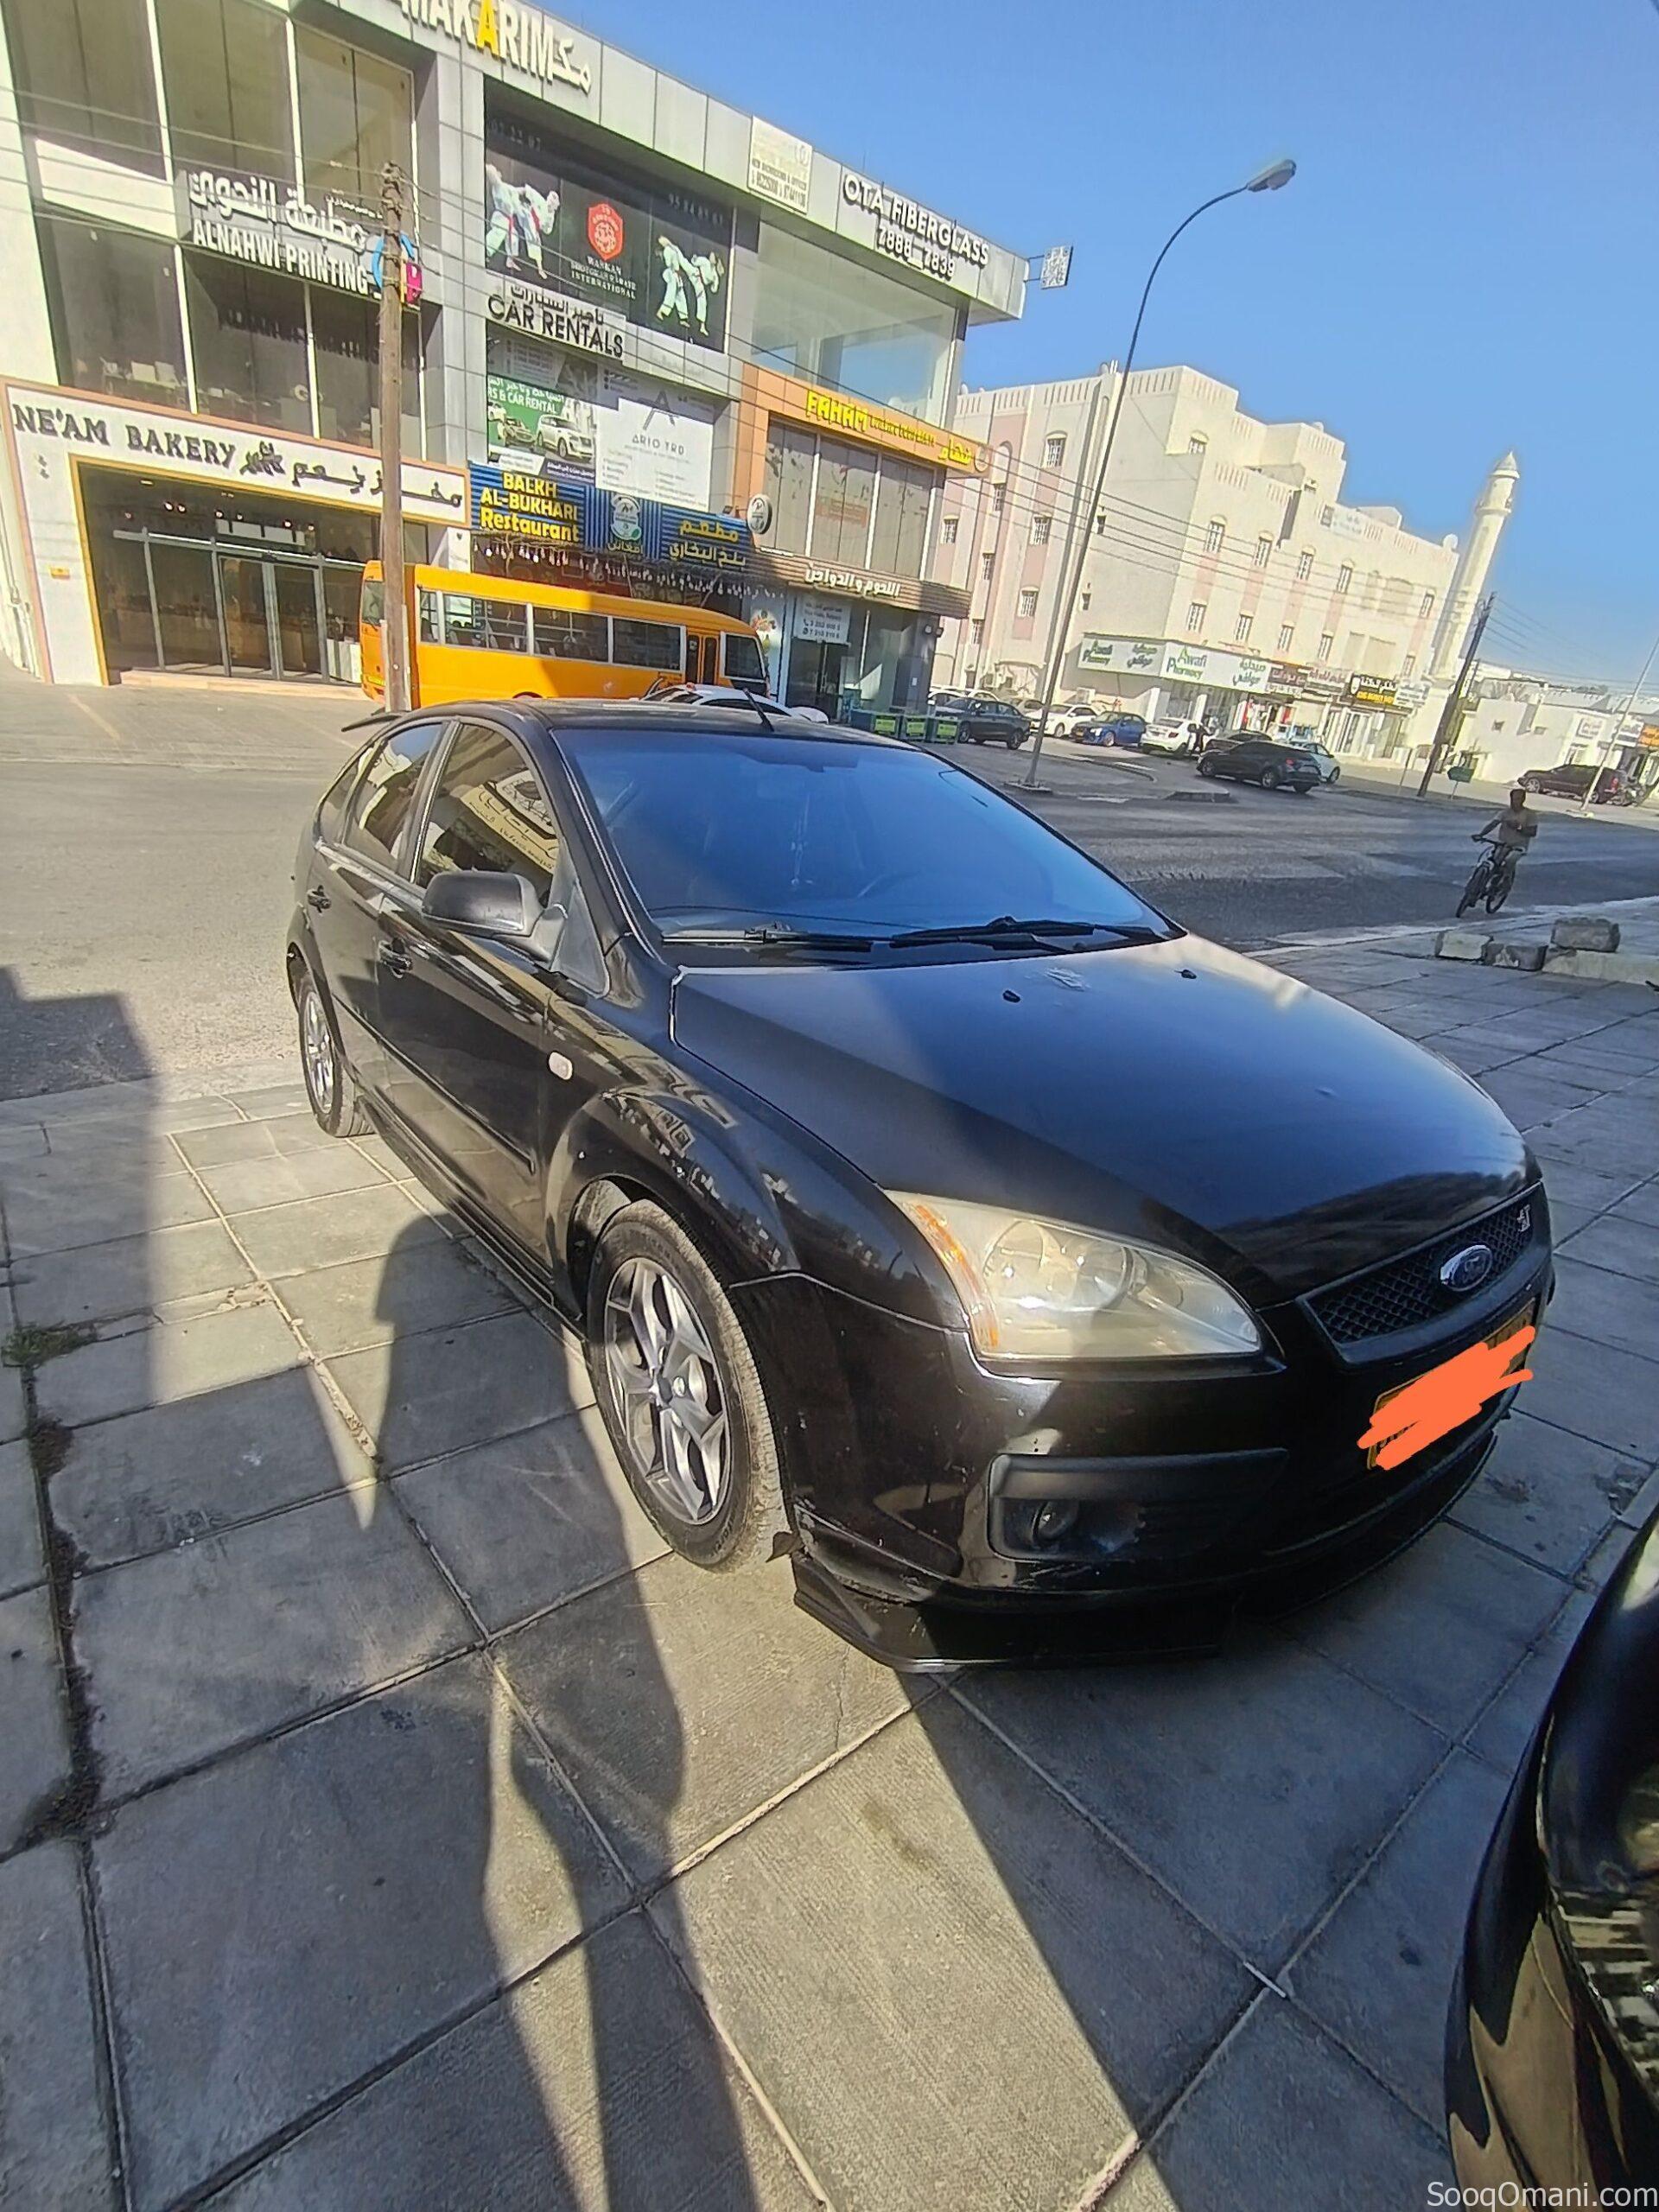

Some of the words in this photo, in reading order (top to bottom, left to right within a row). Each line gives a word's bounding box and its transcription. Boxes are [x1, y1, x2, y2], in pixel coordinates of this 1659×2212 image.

[844, 175, 885, 215] OTA
[892, 196, 989, 265] FIBERGLASS
[194, 218, 281, 270] ALNAHWI
[285, 243, 369, 296] PRINTING
[571, 270, 636, 299] INTERNATIONAL
[488, 294, 535, 330] CAR
[543, 309, 623, 359] RENTALS
[507, 391, 524, 407] CAR
[524, 397, 557, 415] RENTAL
[805, 389, 869, 433] FAHAM
[12, 404, 111, 447] NE'AM
[124, 424, 237, 470] BAKERY
[371, 469, 463, 508] مخز
[503, 471, 557, 499] BALKH
[480, 487, 578, 521] AL-BUKHARI
[480, 505, 581, 543] Restaurant
[679, 518, 739, 543] مطعم
[669, 540, 717, 564] البخاري
[862, 577, 901, 598] اللحوم
[1166, 657, 1204, 680] Pharmacy
[1177, 644, 1208, 668] Awafi
